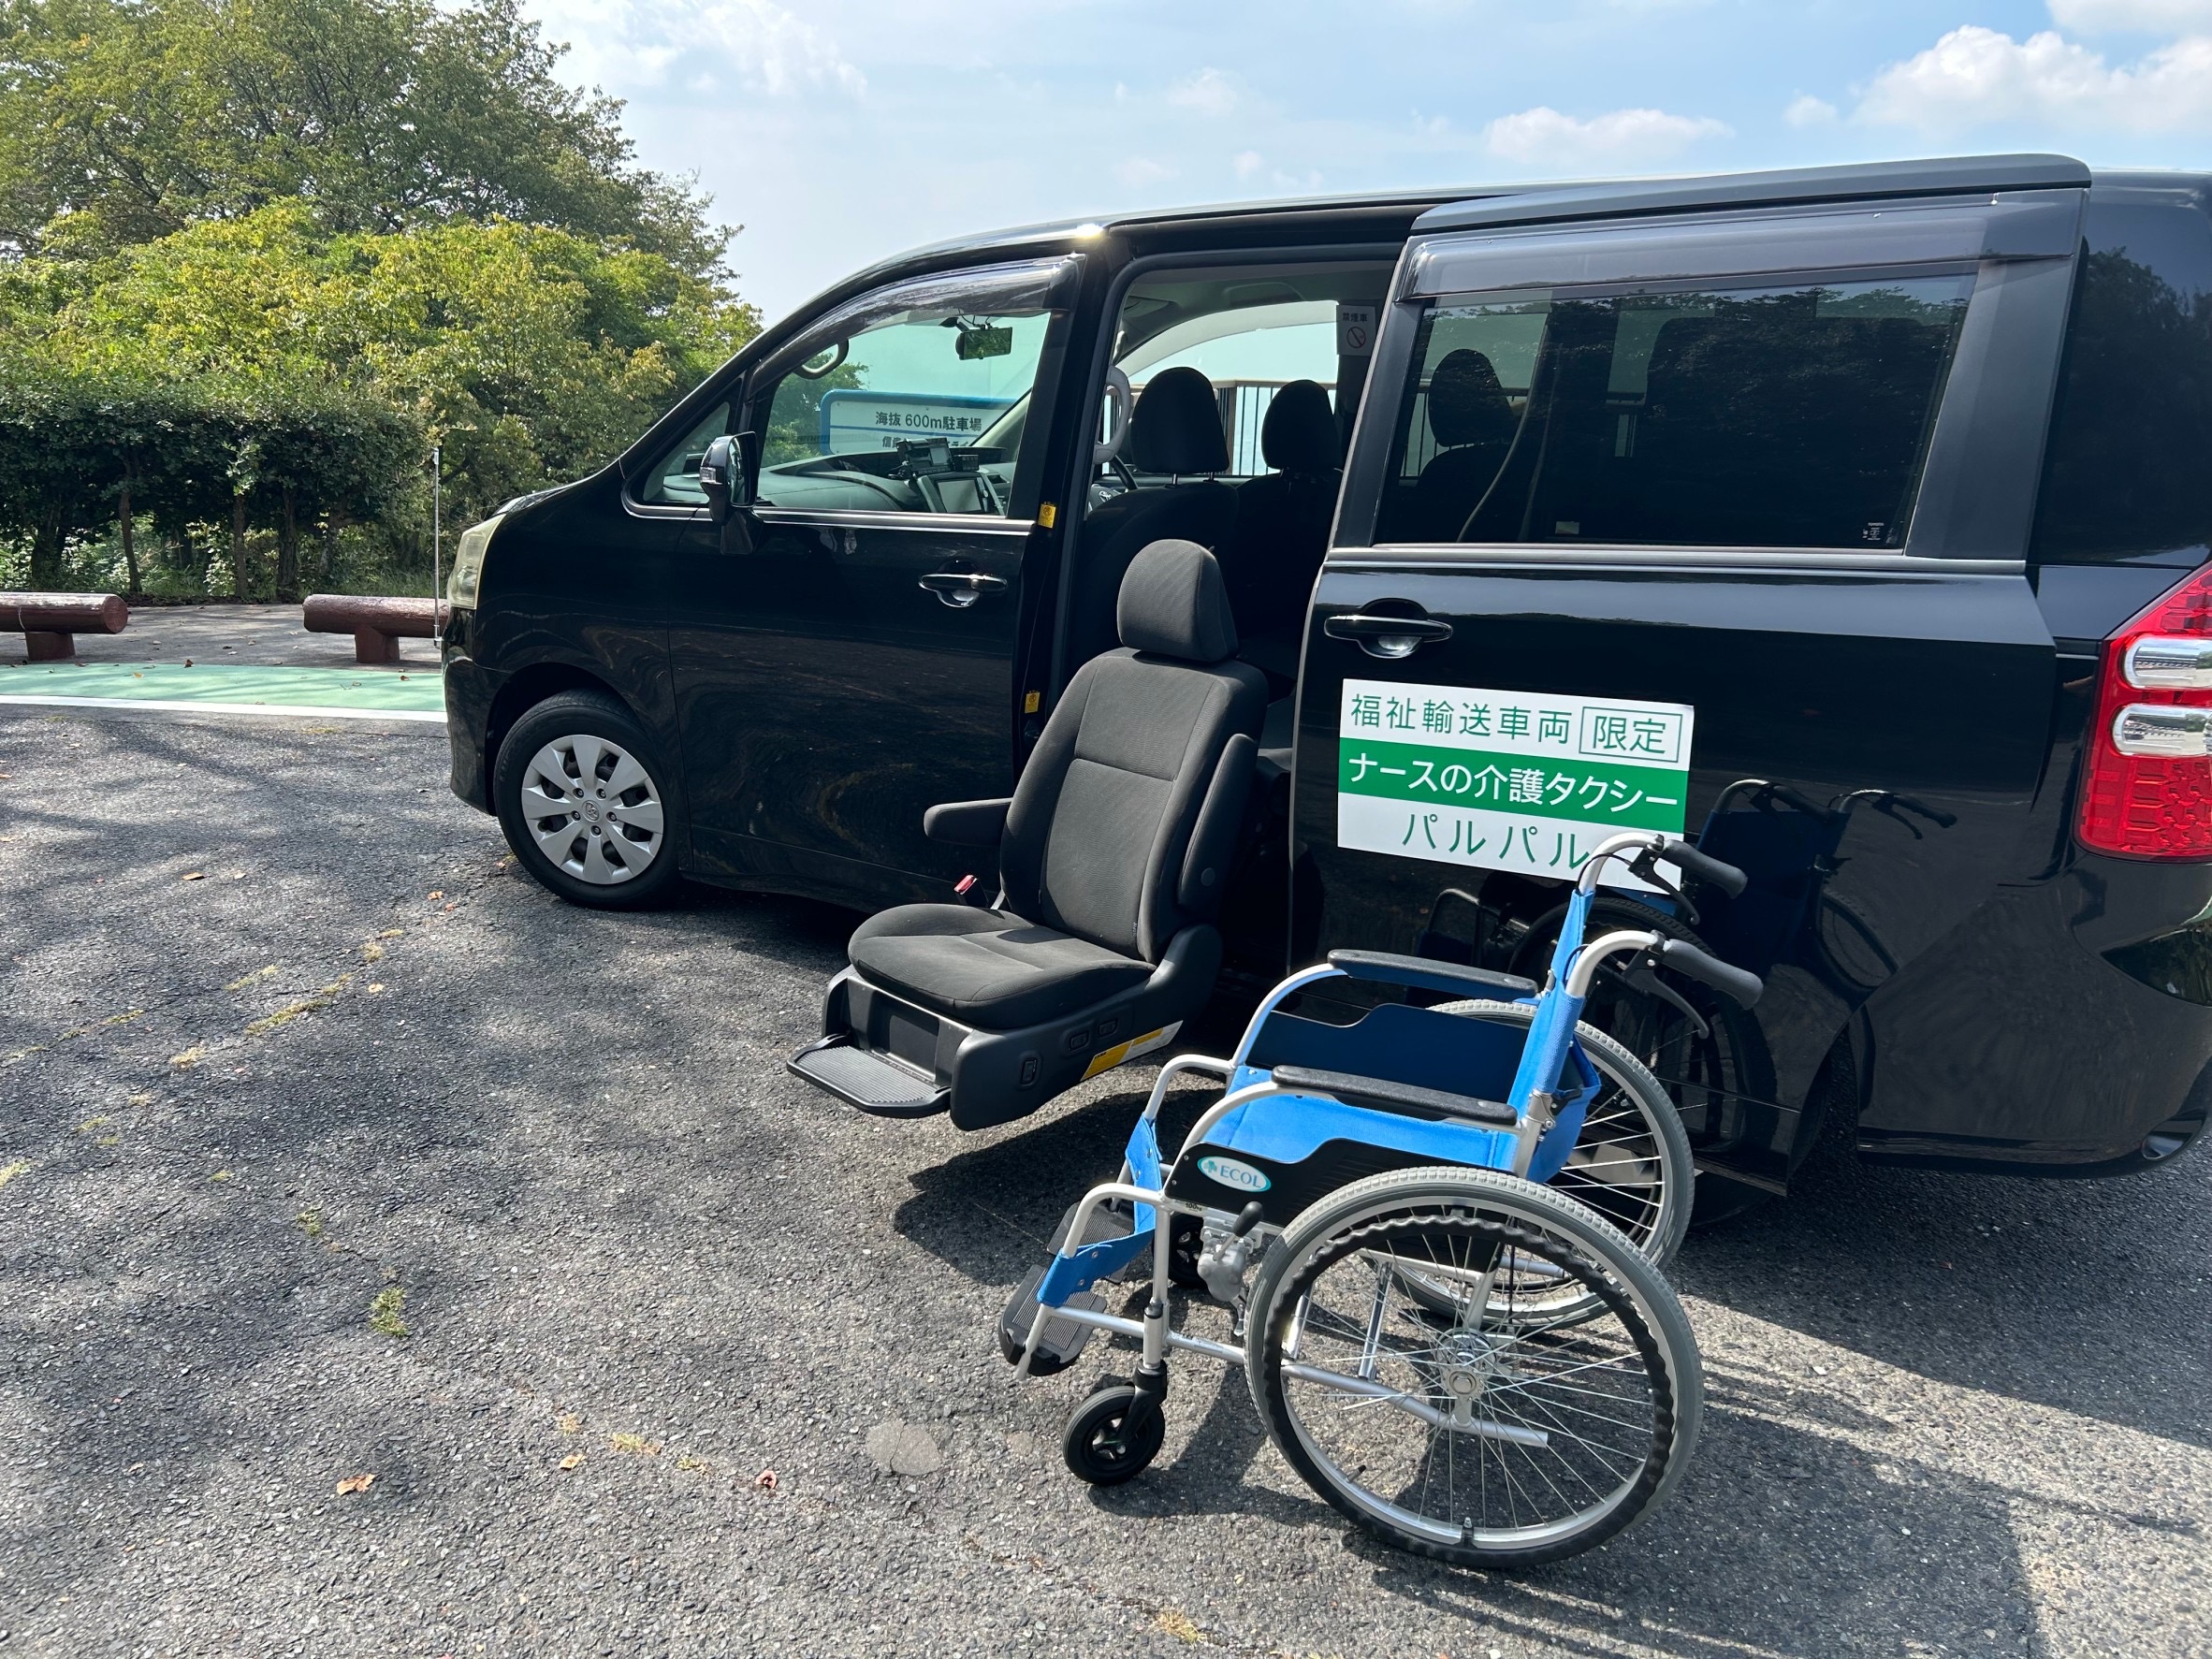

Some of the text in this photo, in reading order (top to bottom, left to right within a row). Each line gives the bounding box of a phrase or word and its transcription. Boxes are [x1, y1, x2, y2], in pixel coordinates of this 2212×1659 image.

[875, 411, 982, 432] 海抜 600m駐車場
[1350, 692, 1666, 755] 福祉輸送車両 限定
[1348, 752, 1678, 813] ナースの介護タクシー
[1402, 813, 1590, 870] パルパル
[1219, 1165, 1261, 1188] ECOL
